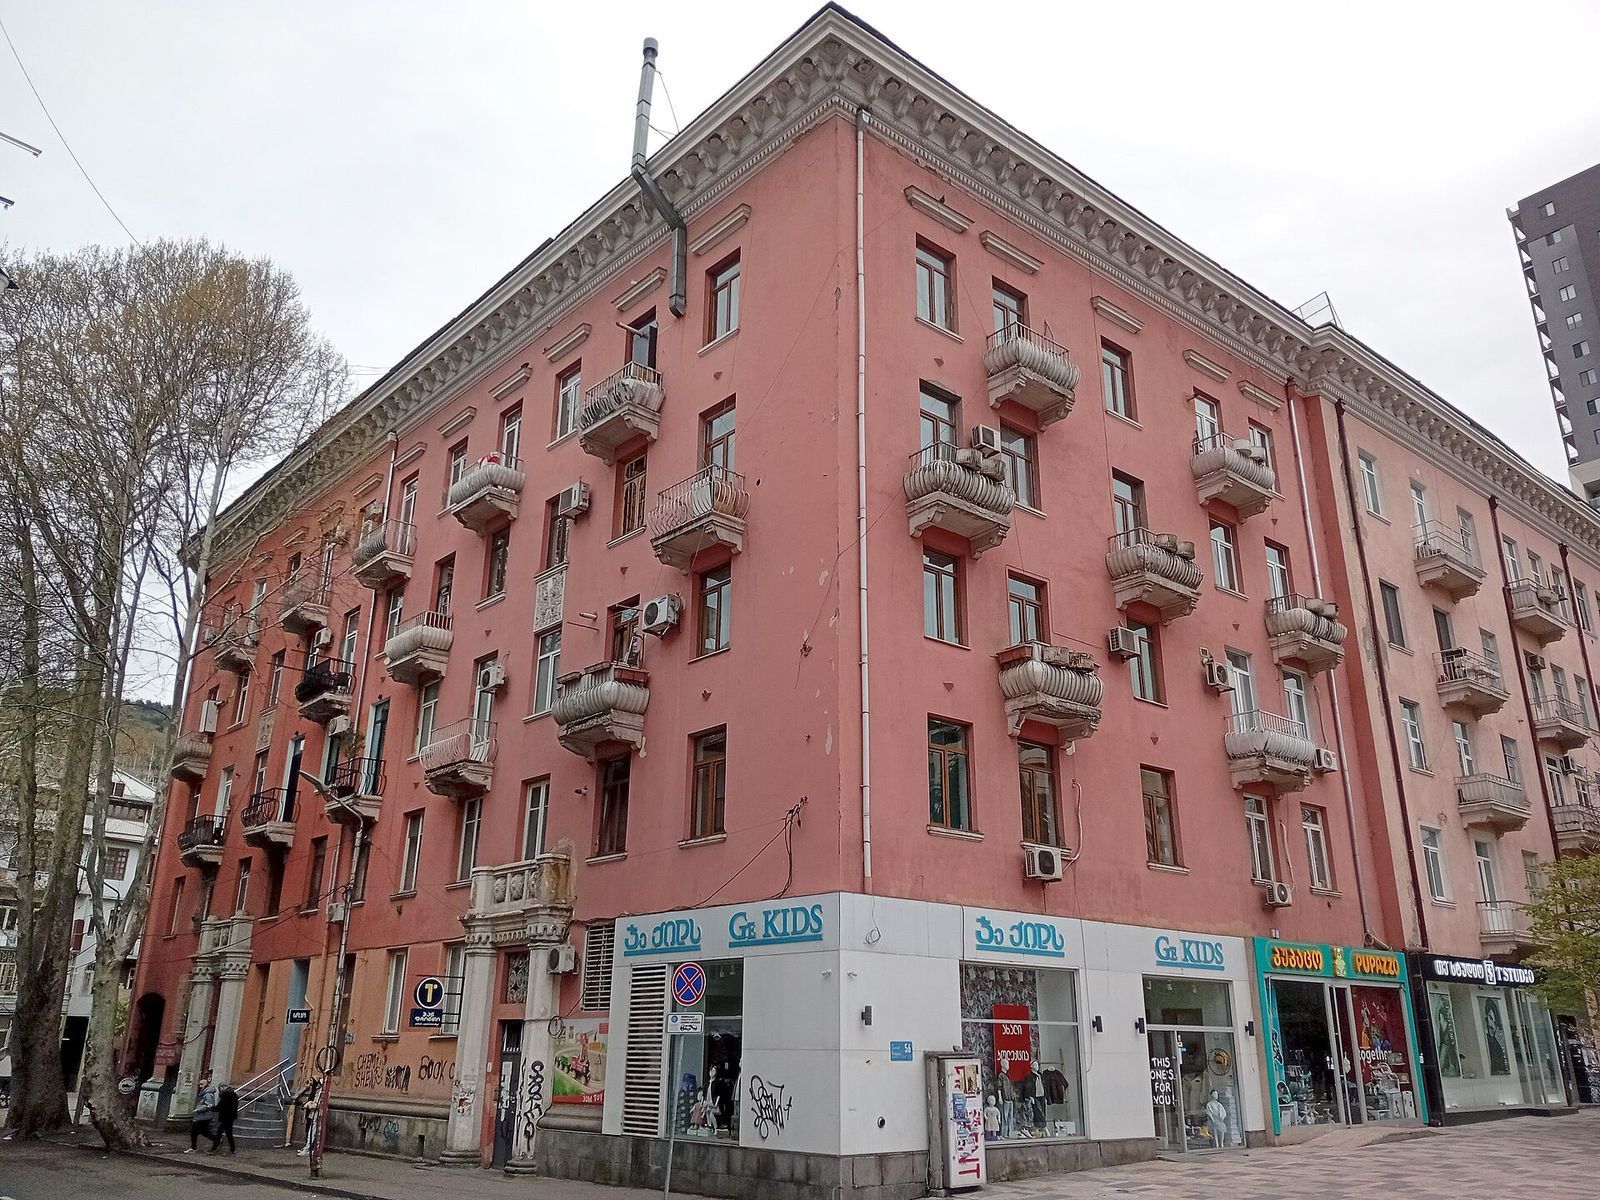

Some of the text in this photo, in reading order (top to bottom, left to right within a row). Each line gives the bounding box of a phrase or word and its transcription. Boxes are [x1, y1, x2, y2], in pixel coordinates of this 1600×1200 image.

[762, 903, 823, 938] KIDS
[1180, 938, 1224, 965] KIDS
[1353, 953, 1400, 976] PUPAZZO
[1151, 1056, 1171, 1068] THIS
[1154, 1081, 1172, 1093] FOR
[1153, 1094, 1176, 1107] YOU!
